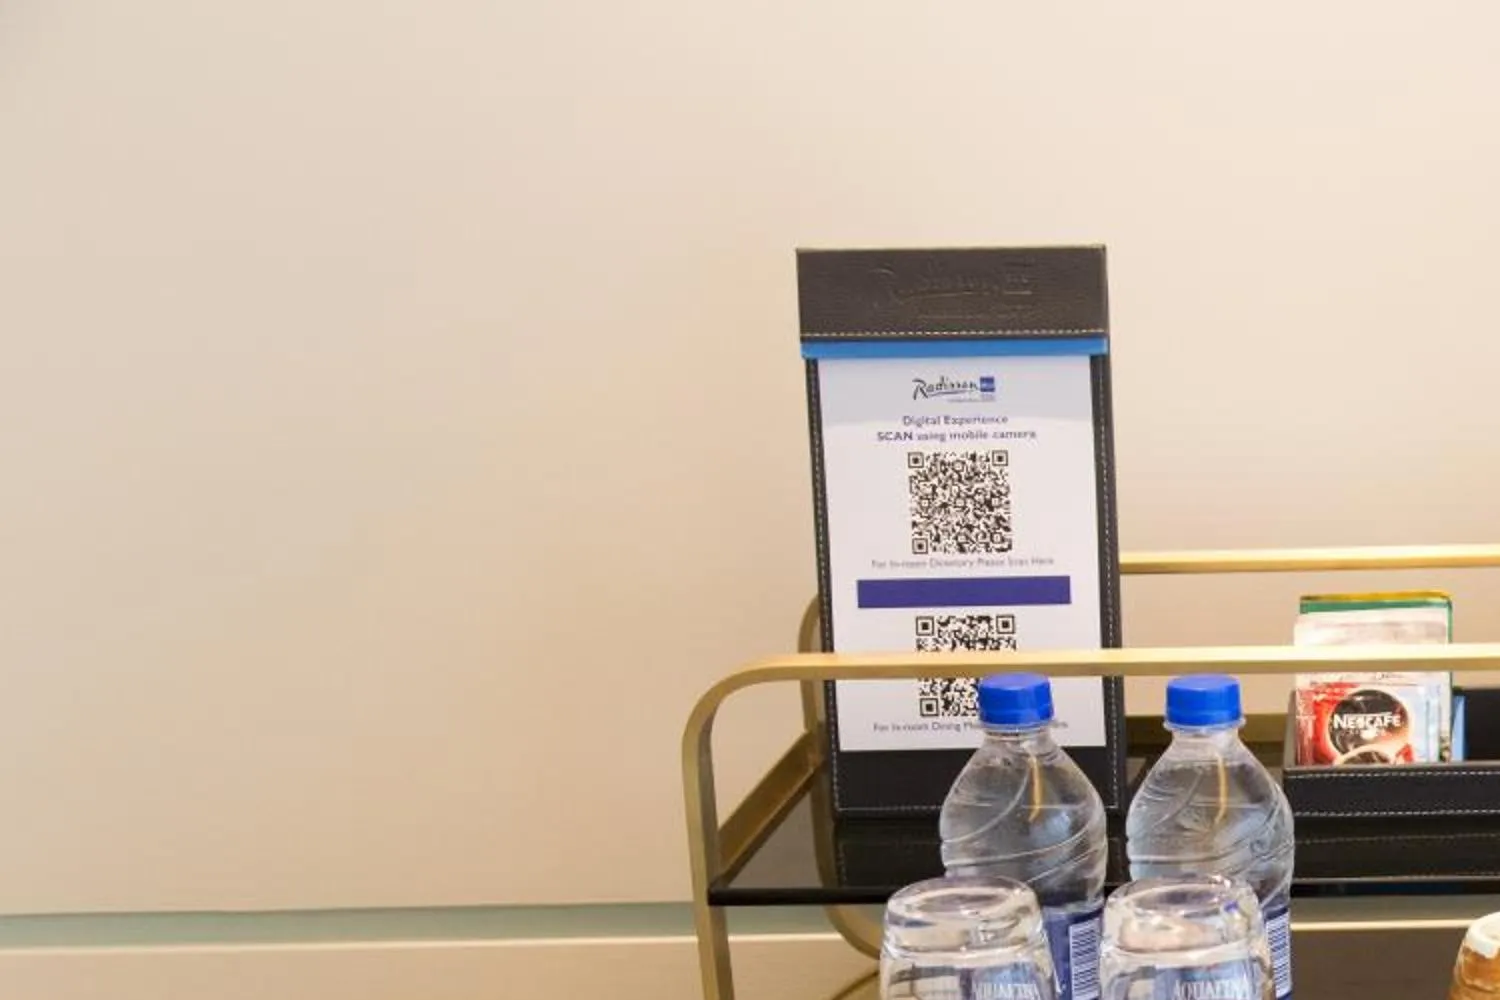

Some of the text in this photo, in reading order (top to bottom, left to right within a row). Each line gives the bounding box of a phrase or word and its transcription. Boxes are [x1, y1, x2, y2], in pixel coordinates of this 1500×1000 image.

[902, 414, 1009, 428] Digital Experience
[877, 429, 1037, 443] SCAN using mobile camera
